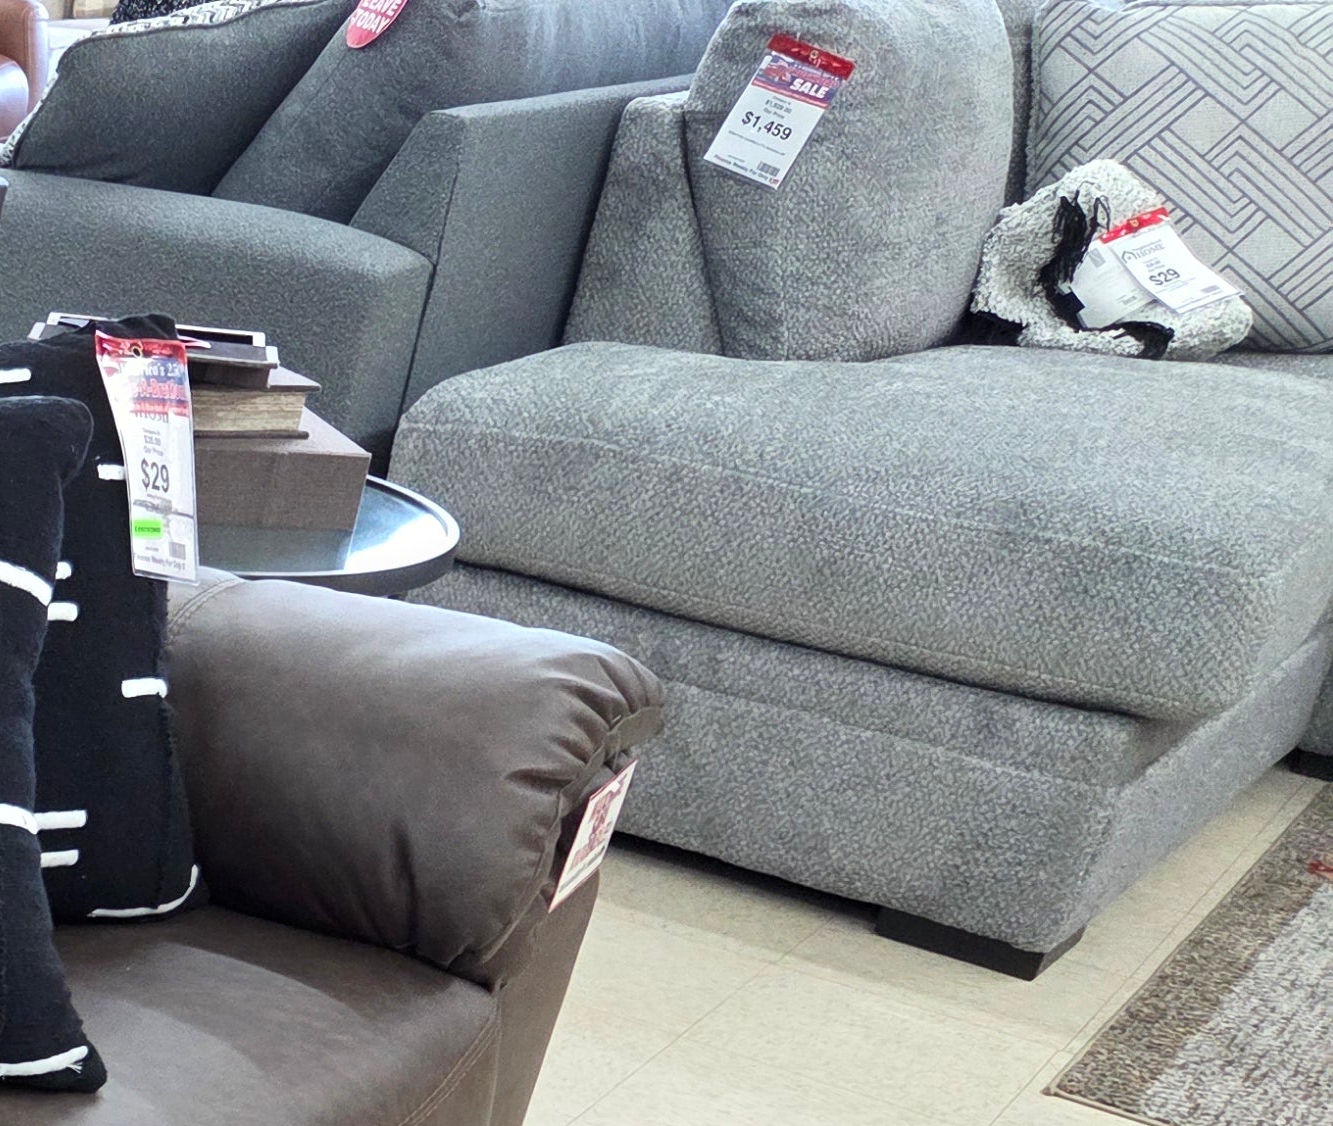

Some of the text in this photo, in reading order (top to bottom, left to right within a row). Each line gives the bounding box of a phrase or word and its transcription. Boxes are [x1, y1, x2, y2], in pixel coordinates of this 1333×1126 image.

[351, 8, 391, 33] TODAY
[790, 78, 829, 99] SALE
[741, 111, 792, 141] $1,459
[1149, 268, 1180, 286] $29
[141, 457, 170, 493] $29
